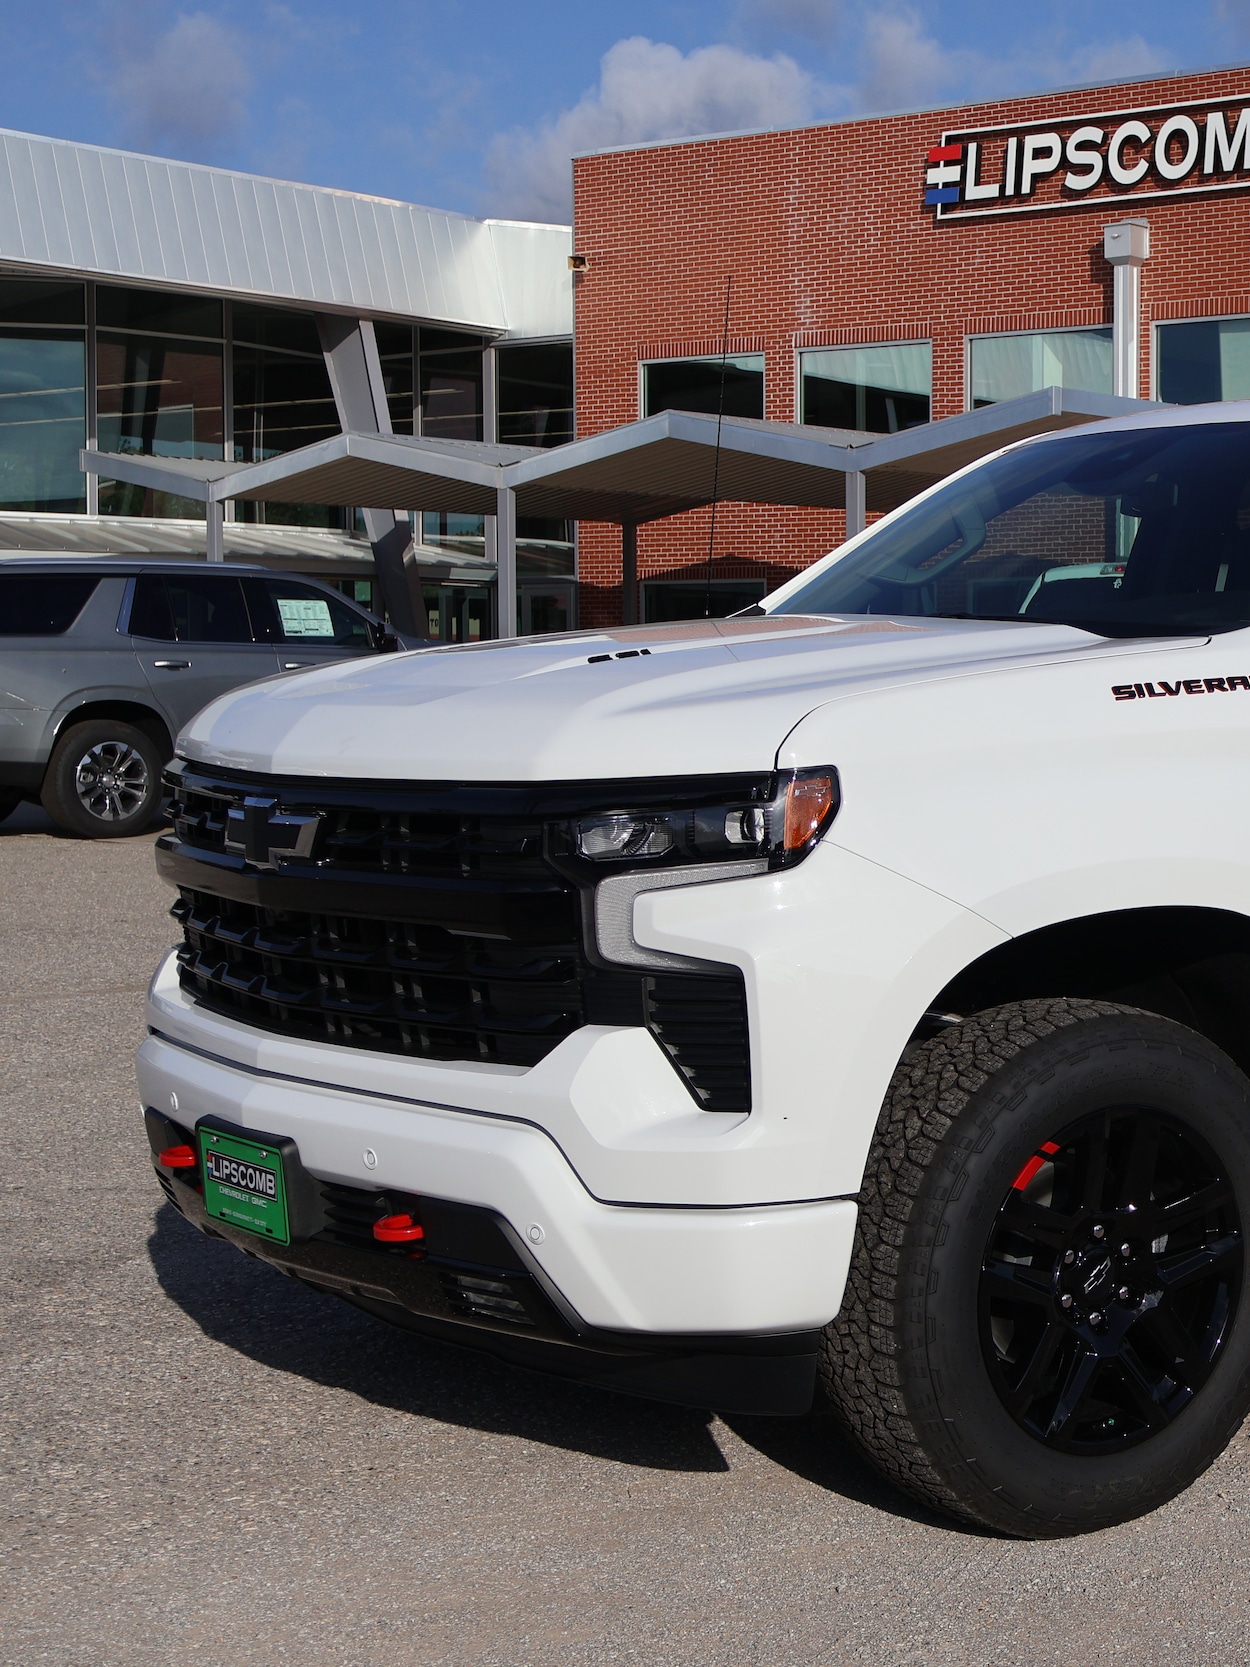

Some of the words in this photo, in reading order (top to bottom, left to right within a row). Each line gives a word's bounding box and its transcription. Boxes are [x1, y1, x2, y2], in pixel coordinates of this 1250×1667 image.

[212, 1156, 275, 1195] LIPSCOMB
[219, 1186, 249, 1202] CHEVROLET
[251, 1197, 267, 1208] GMC
